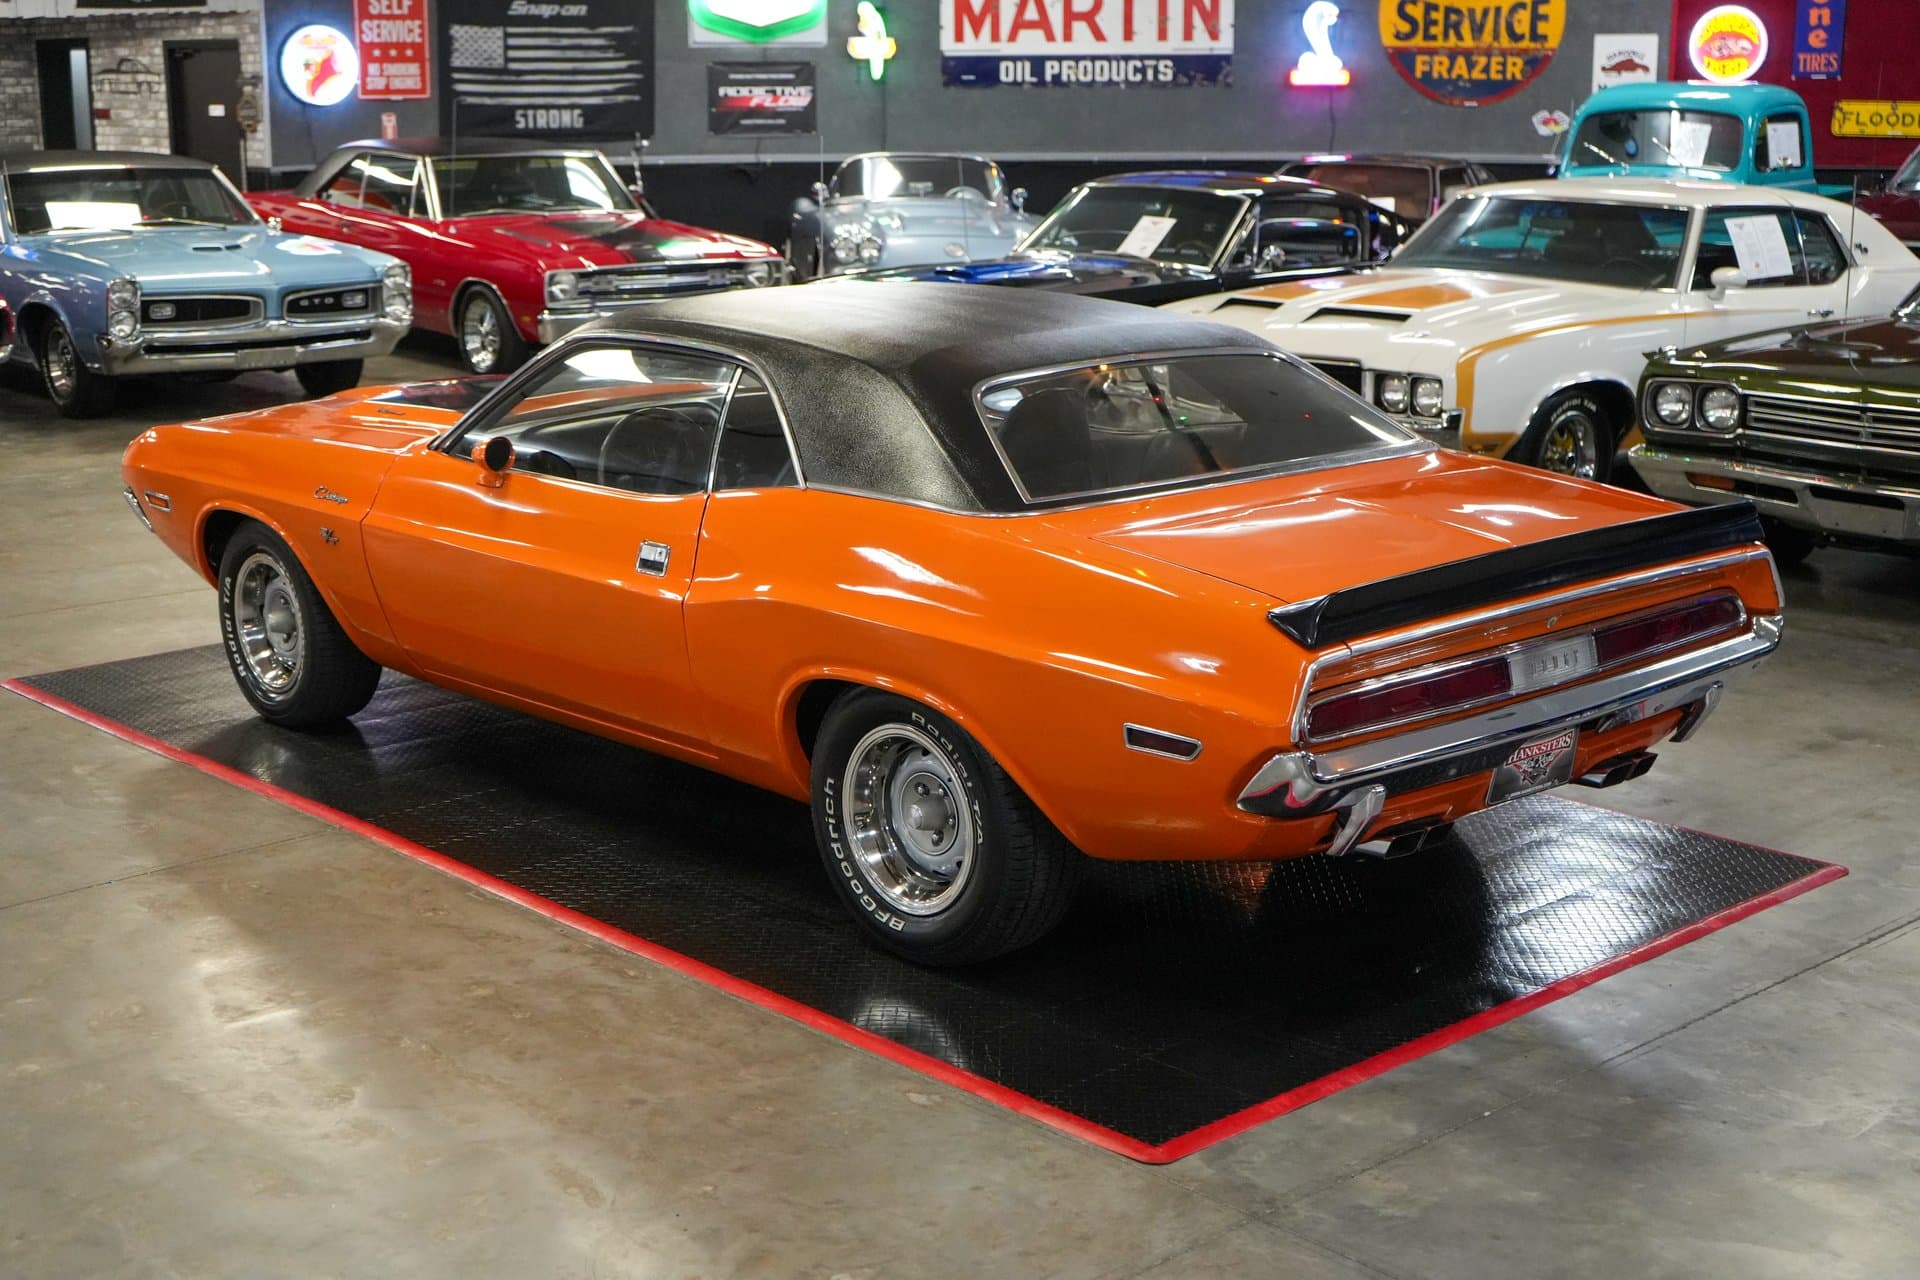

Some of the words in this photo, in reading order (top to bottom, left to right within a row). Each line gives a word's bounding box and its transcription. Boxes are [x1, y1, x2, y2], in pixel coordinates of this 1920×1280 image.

[368, 0, 414, 15] SELF
[507, 0, 588, 19] Snap-on
[361, 19, 423, 43] SERVICE
[1393, 0, 1551, 43] SERVICE
[999, 60, 1038, 83] OIL
[1044, 60, 1174, 83] PRODUCTS
[1414, 54, 1525, 81] FRAZER
[1797, 52, 1839, 73] TIRES
[514, 108, 585, 129] STRONG
[1842, 110, 1920, 128] FLOOD
[1507, 732, 1572, 764] HANKSTERS
[911, 711, 974, 789] Radial
[972, 799, 985, 846] T/A
[823, 777, 906, 932] BFGoodrich
